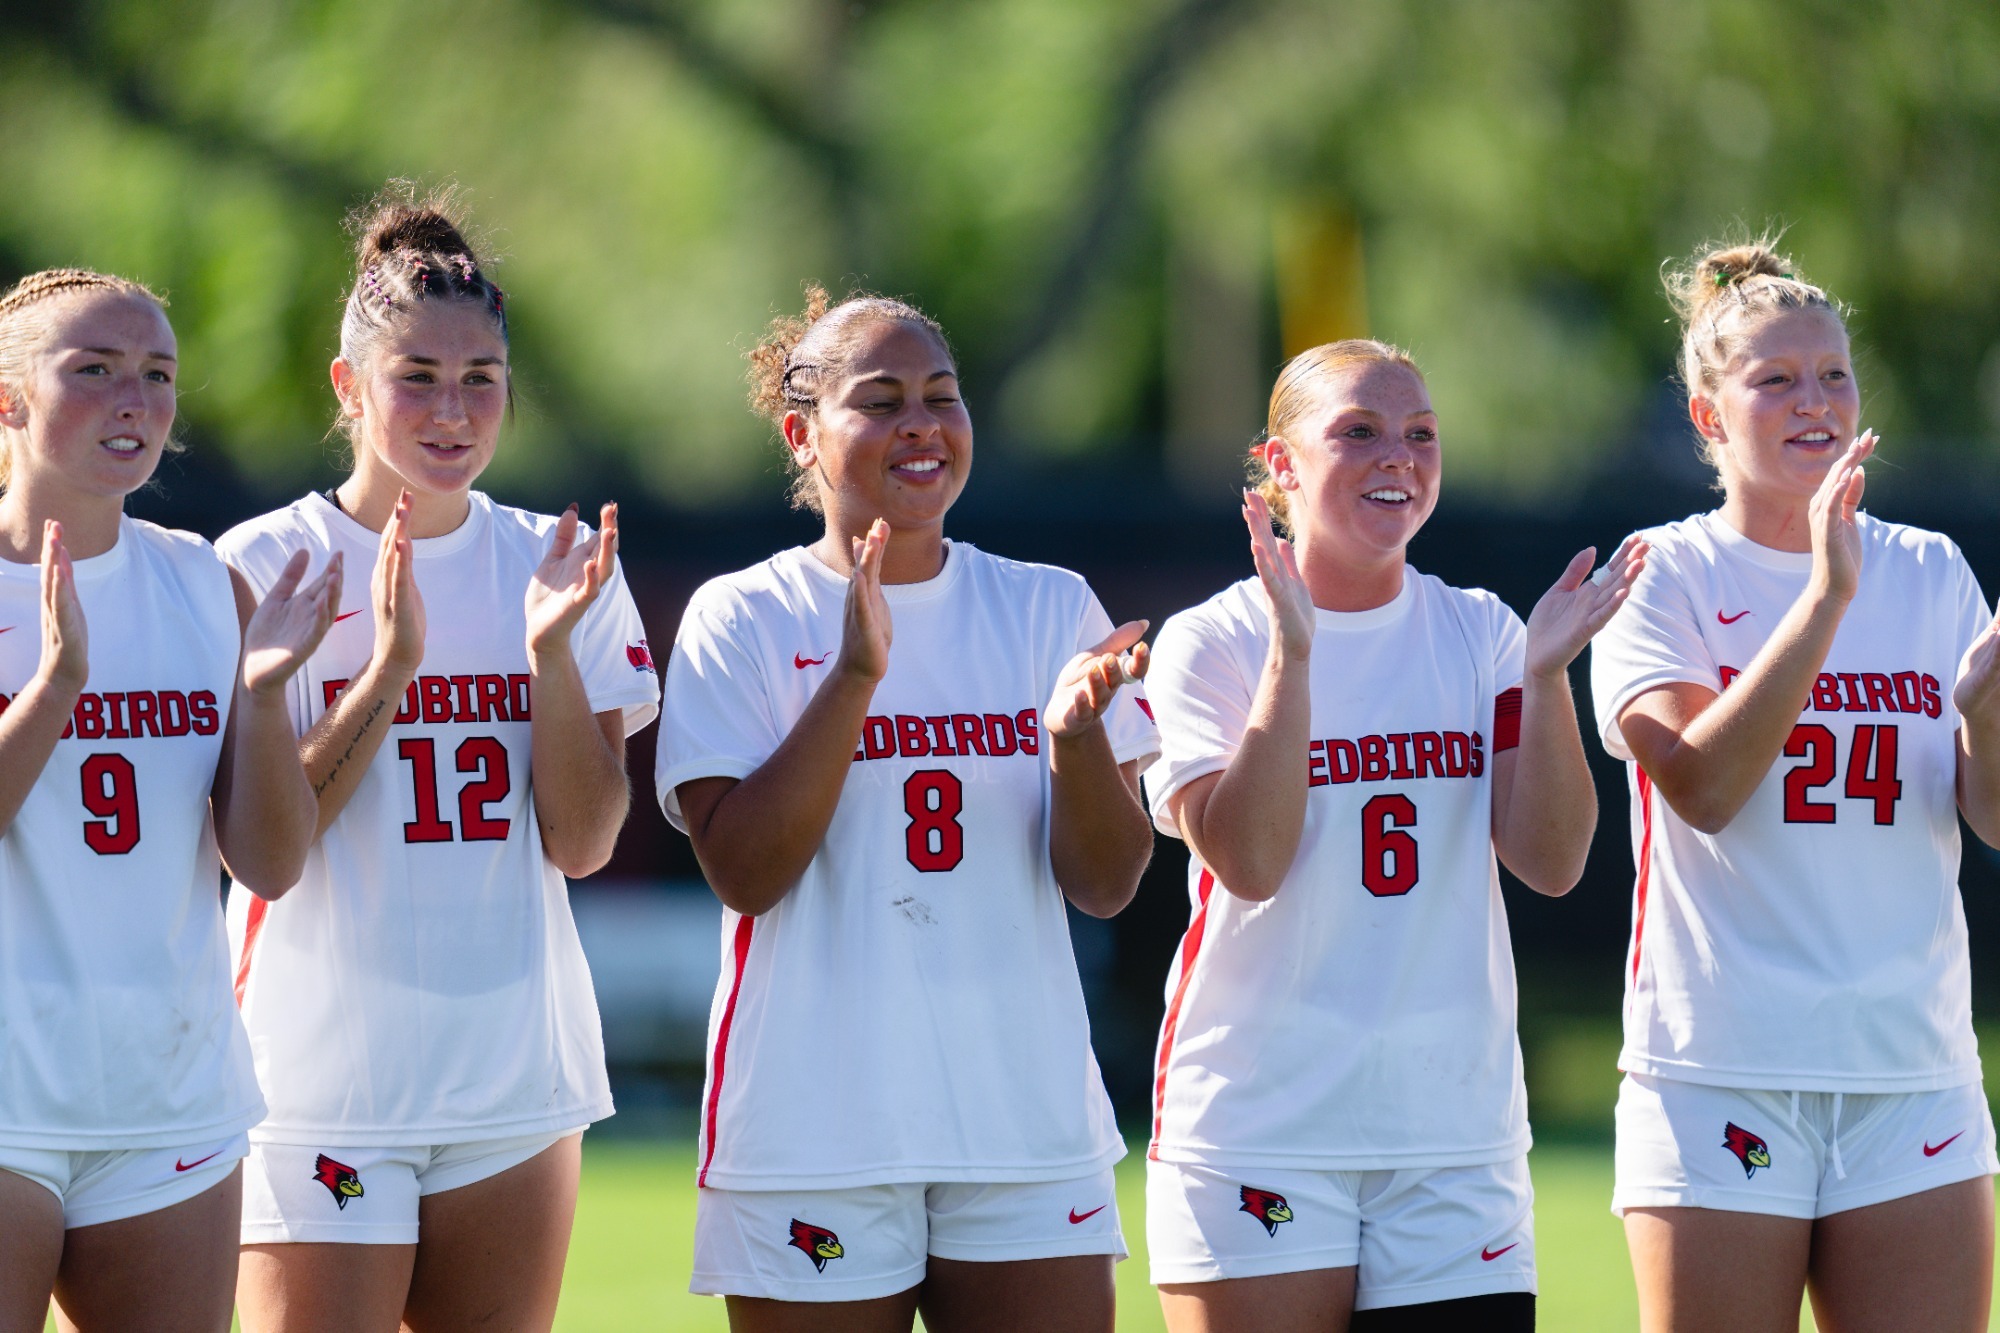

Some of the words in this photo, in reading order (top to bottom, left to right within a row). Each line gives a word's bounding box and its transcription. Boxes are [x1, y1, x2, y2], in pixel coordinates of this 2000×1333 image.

[322, 674, 531, 724] DBIRD
[852, 708, 1039, 762] DBIRDS
[1719, 665, 1942, 719] BIRDS
[80, 753, 141, 855] 9
[398, 736, 511, 843] 12
[1308, 731, 1484, 787] EDBIRDS
[1783, 724, 1902, 826] 24
[903, 769, 963, 873] 8
[1361, 793, 1419, 897] 6
